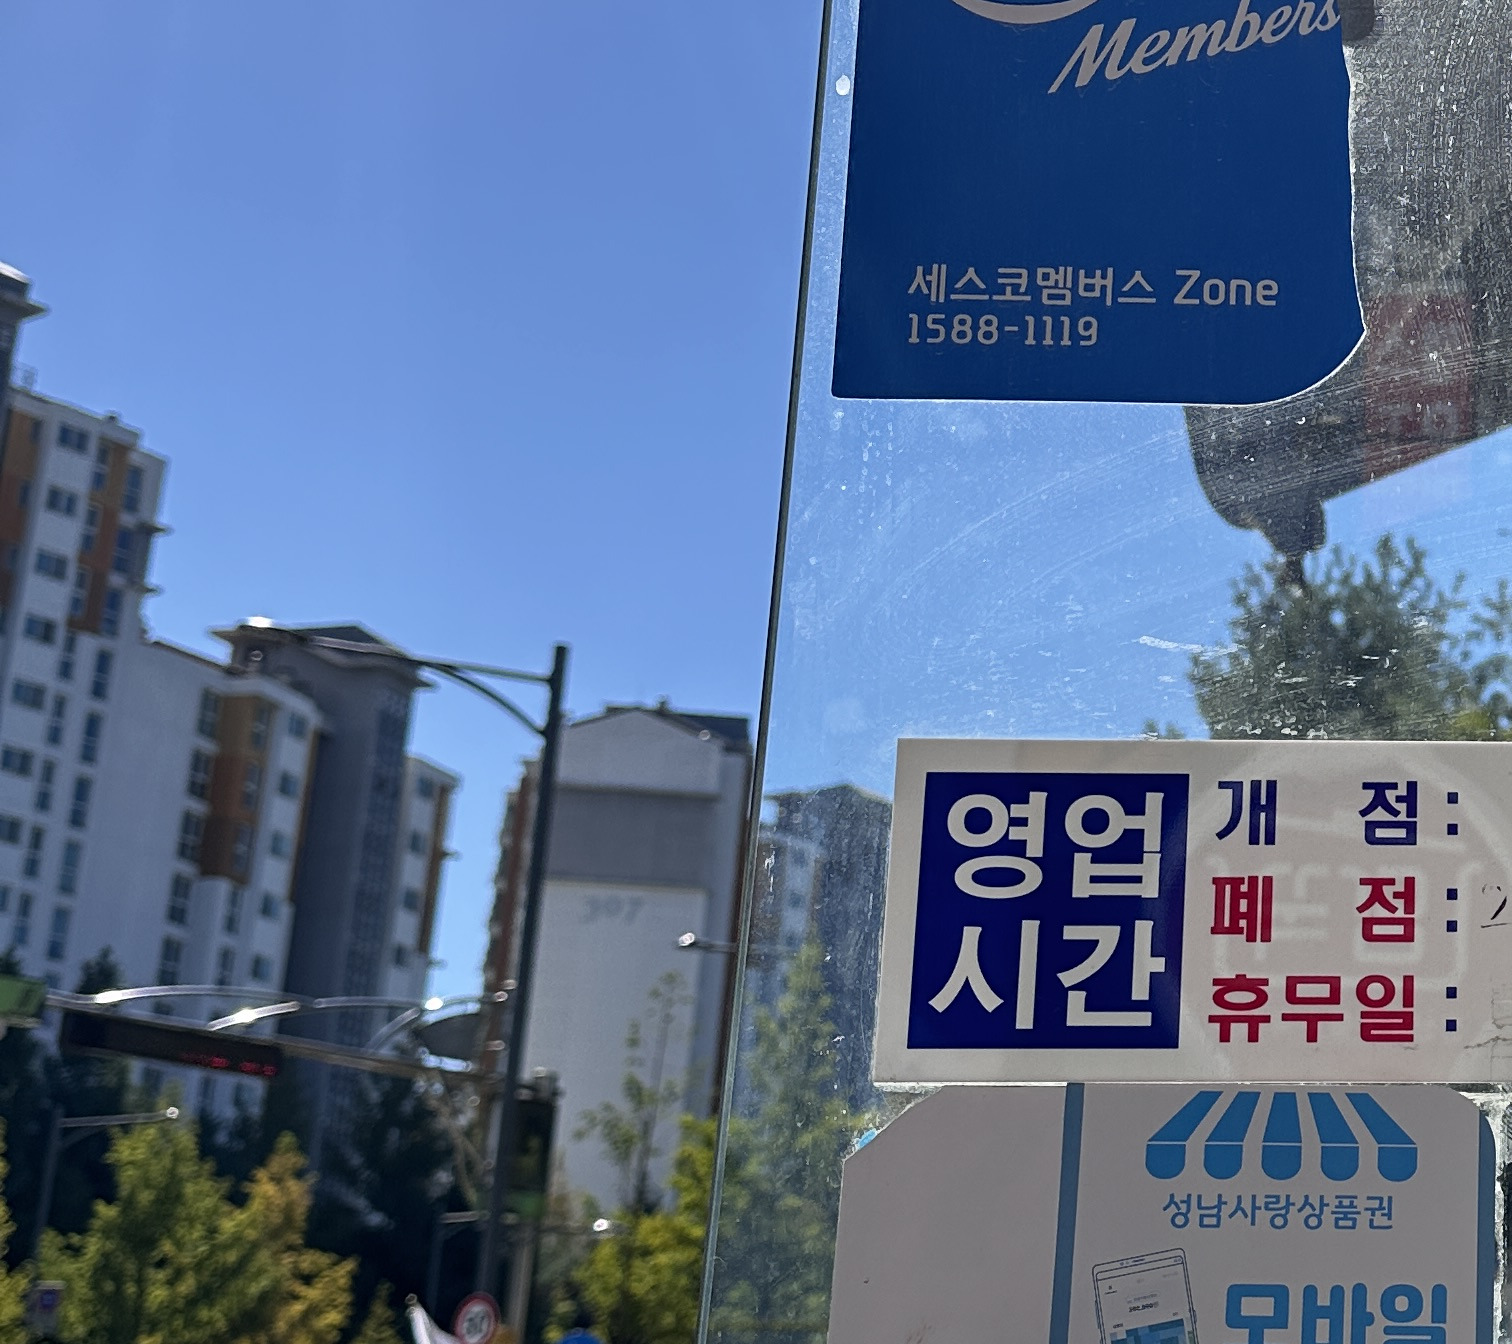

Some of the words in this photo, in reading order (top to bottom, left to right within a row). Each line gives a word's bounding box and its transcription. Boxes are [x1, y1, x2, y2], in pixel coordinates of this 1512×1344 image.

[908, 264, 1157, 306] 세스코멤버스
[1174, 268, 1280, 306] Zone
[908, 314, 1099, 346] 1588-1119
[947, 791, 1165, 899] 영업
[928, 919, 1166, 1030] 시간
[1162, 1192, 1395, 1230] 성남사랑상품권
